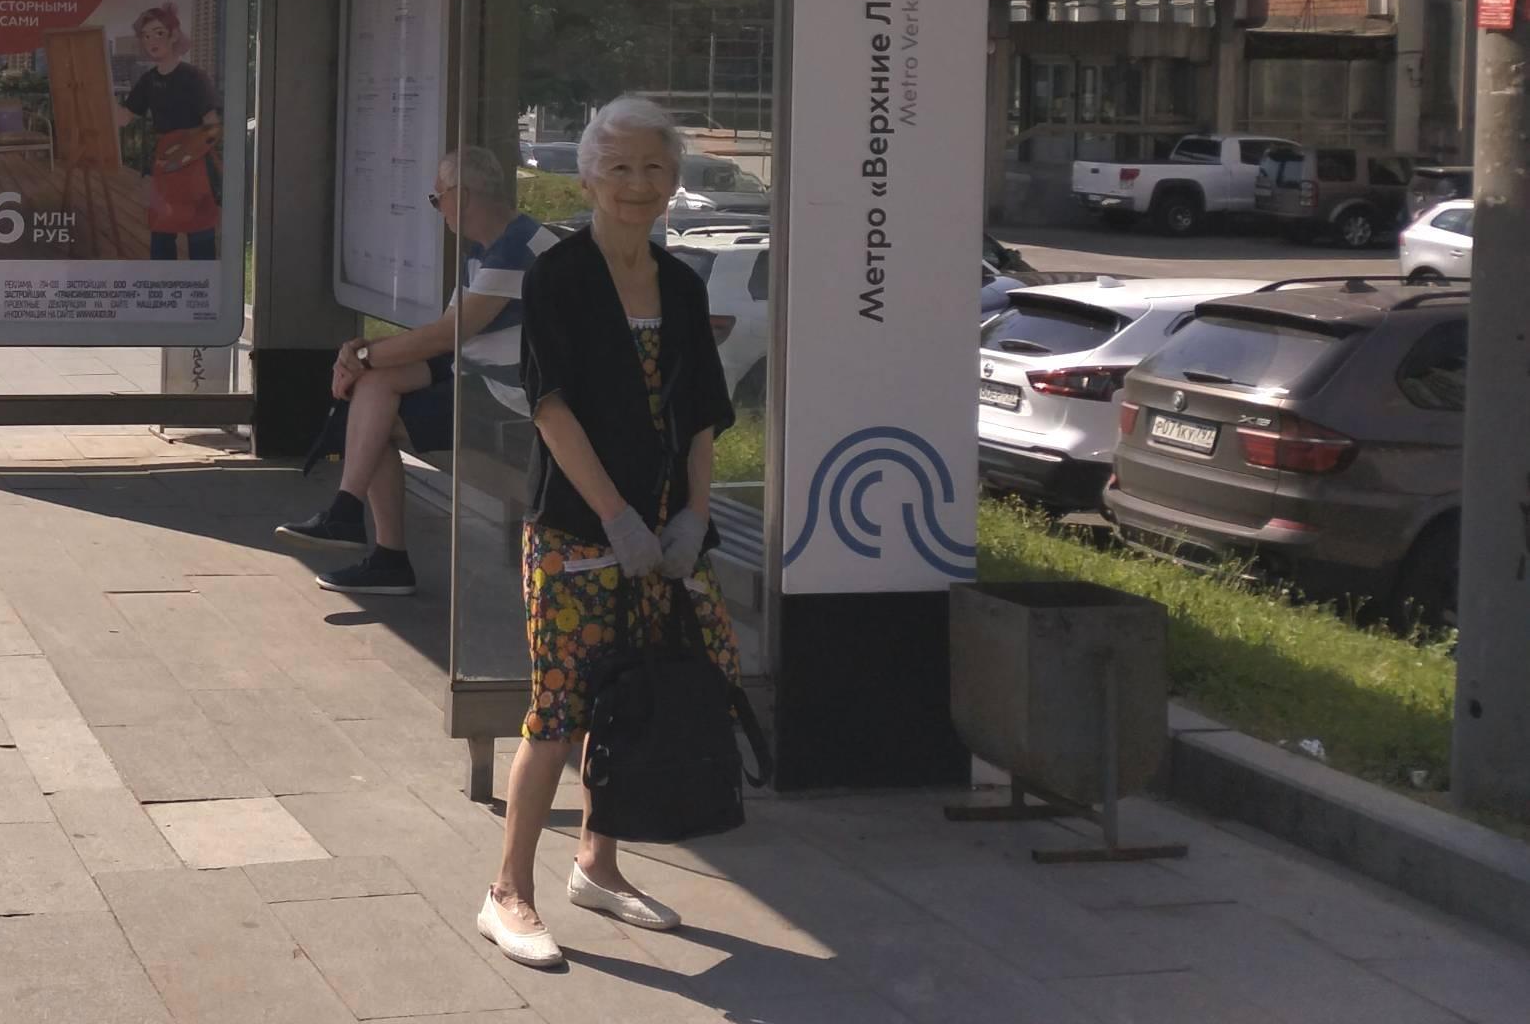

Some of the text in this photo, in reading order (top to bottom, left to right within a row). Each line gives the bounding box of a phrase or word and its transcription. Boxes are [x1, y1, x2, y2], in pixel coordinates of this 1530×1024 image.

[861, 32, 895, 198] «Верхние
[898, 56, 920, 127] Metro
[33, 212, 76, 227] МЛН
[33, 228, 76, 243] РУБ.
[858, 207, 892, 324] Метро
